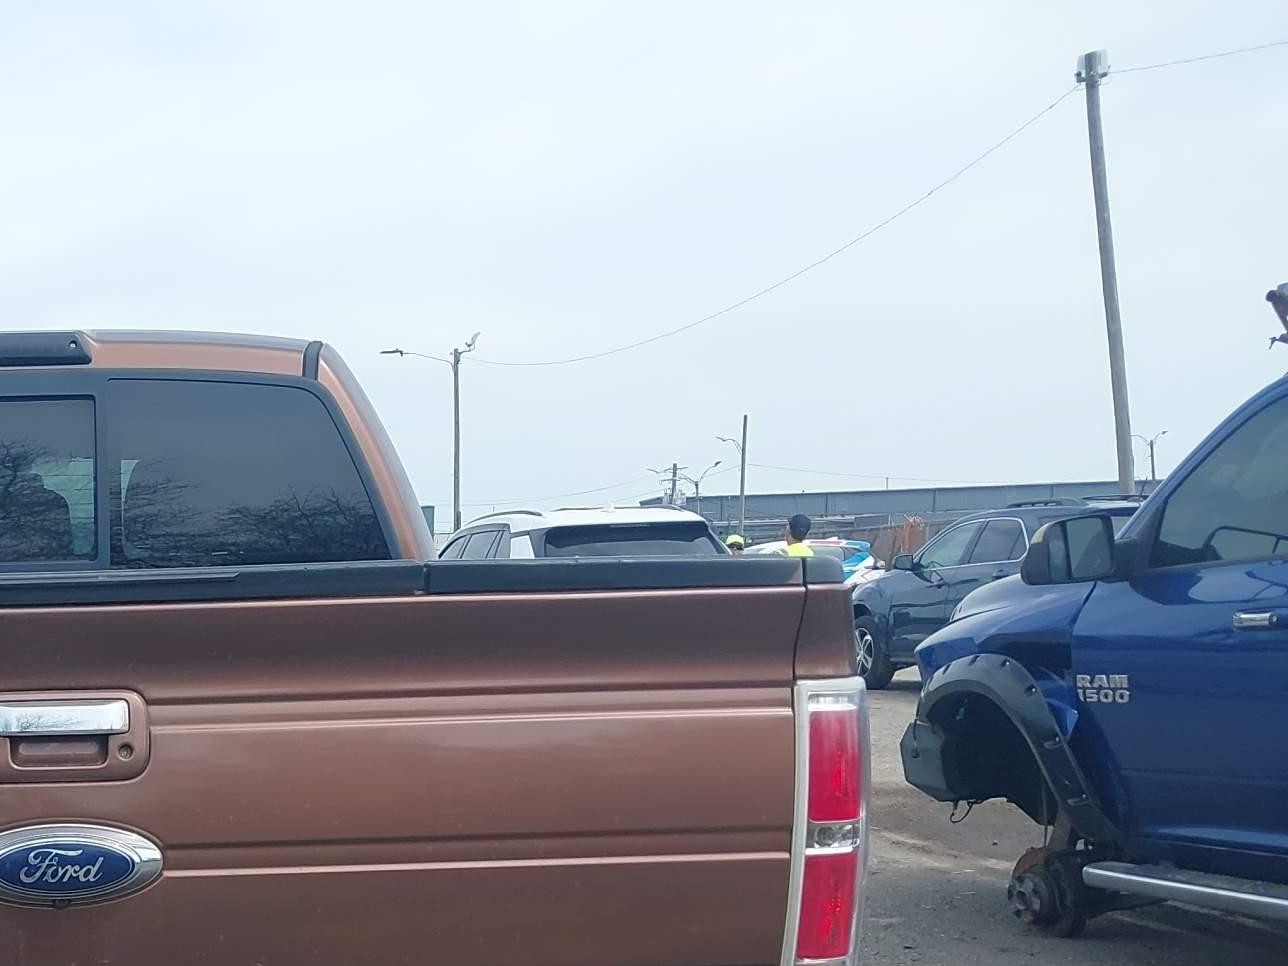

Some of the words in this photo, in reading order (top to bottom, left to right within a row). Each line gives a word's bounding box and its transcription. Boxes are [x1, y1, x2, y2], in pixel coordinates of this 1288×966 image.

[1076, 674, 1129, 688] RAM
[1077, 689, 1131, 703] 1500
[19, 848, 104, 883] Ford
